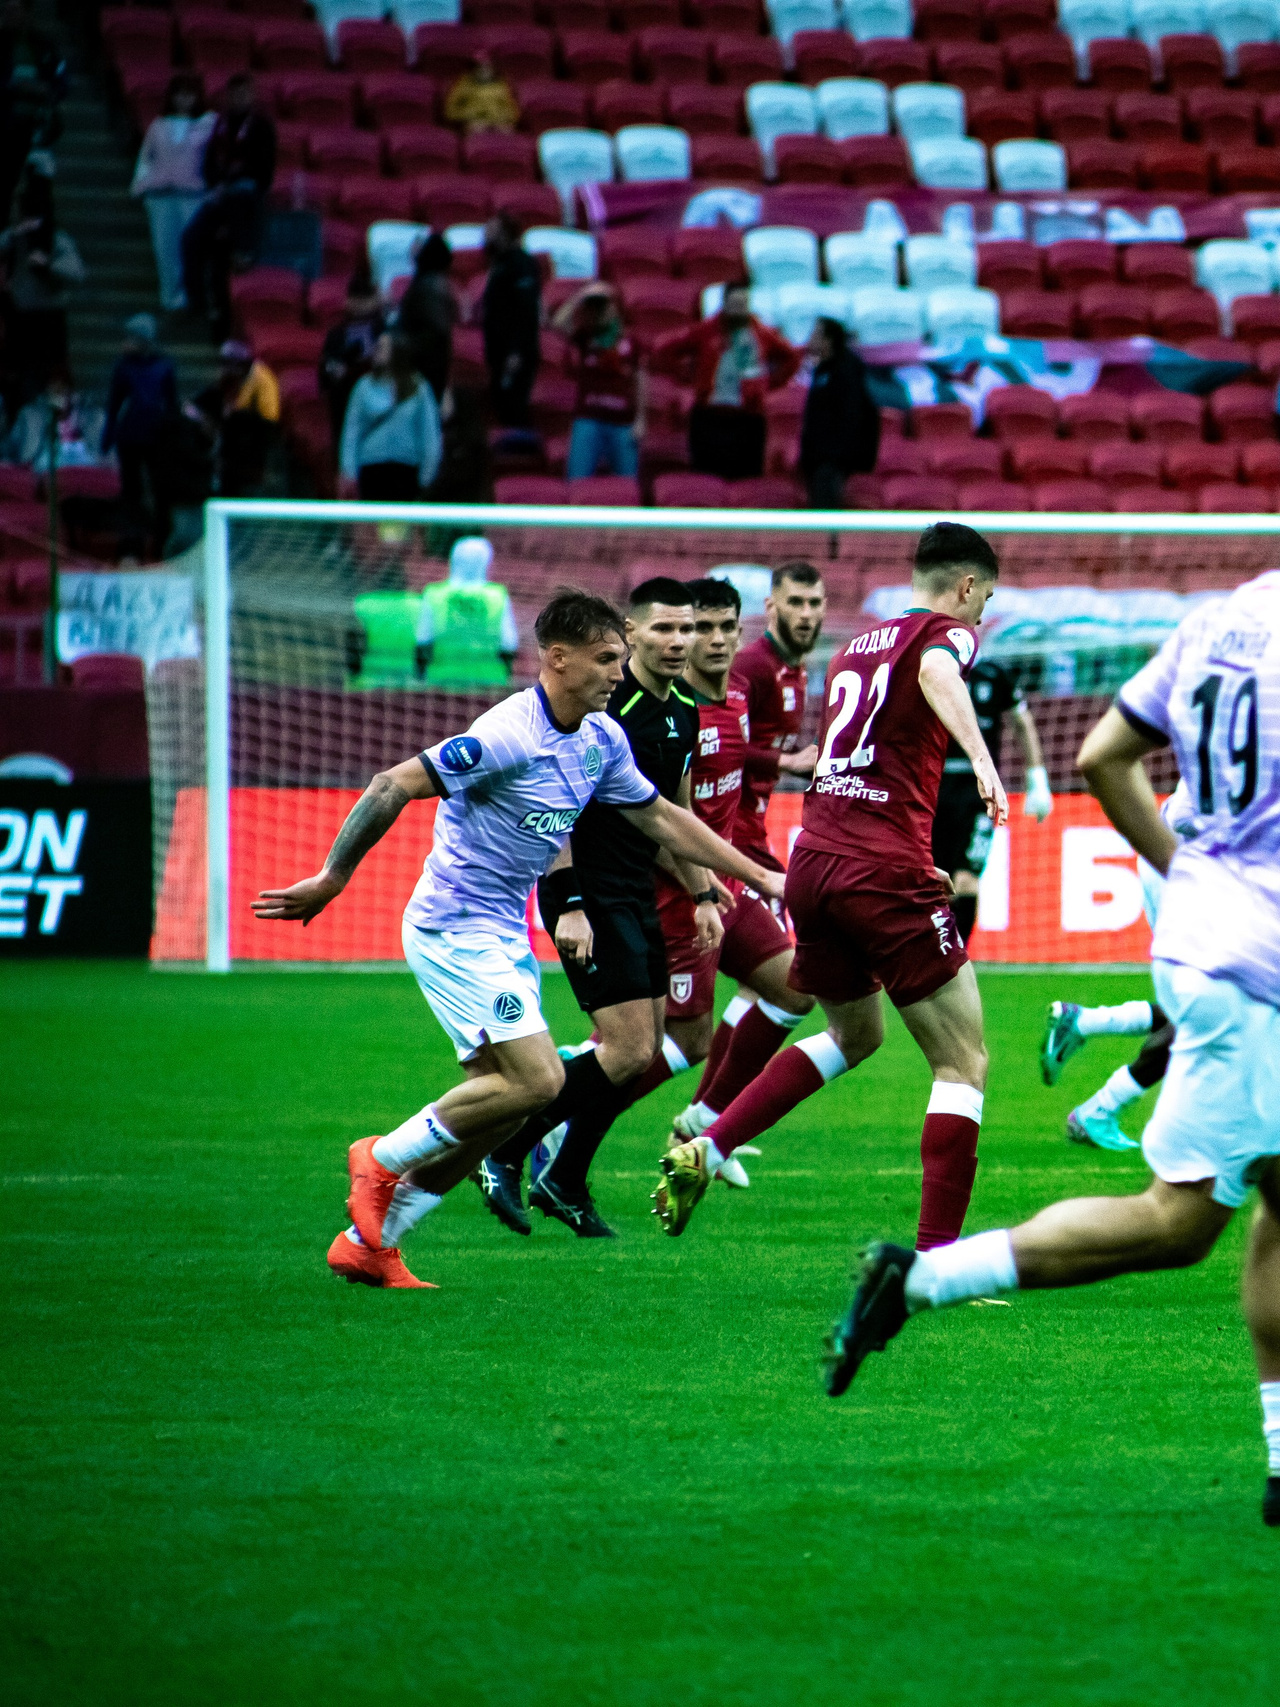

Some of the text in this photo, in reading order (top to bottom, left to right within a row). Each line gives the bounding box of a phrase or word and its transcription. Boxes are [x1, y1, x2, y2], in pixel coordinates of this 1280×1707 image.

[844, 626, 900, 657] ХОДЖА
[700, 739, 721, 757] BET
[816, 662, 890, 777] 22
[1191, 673, 1259, 817] 19
[0, 808, 88, 872] ON
[517, 808, 583, 834] FONB
[0, 875, 84, 938] ET
